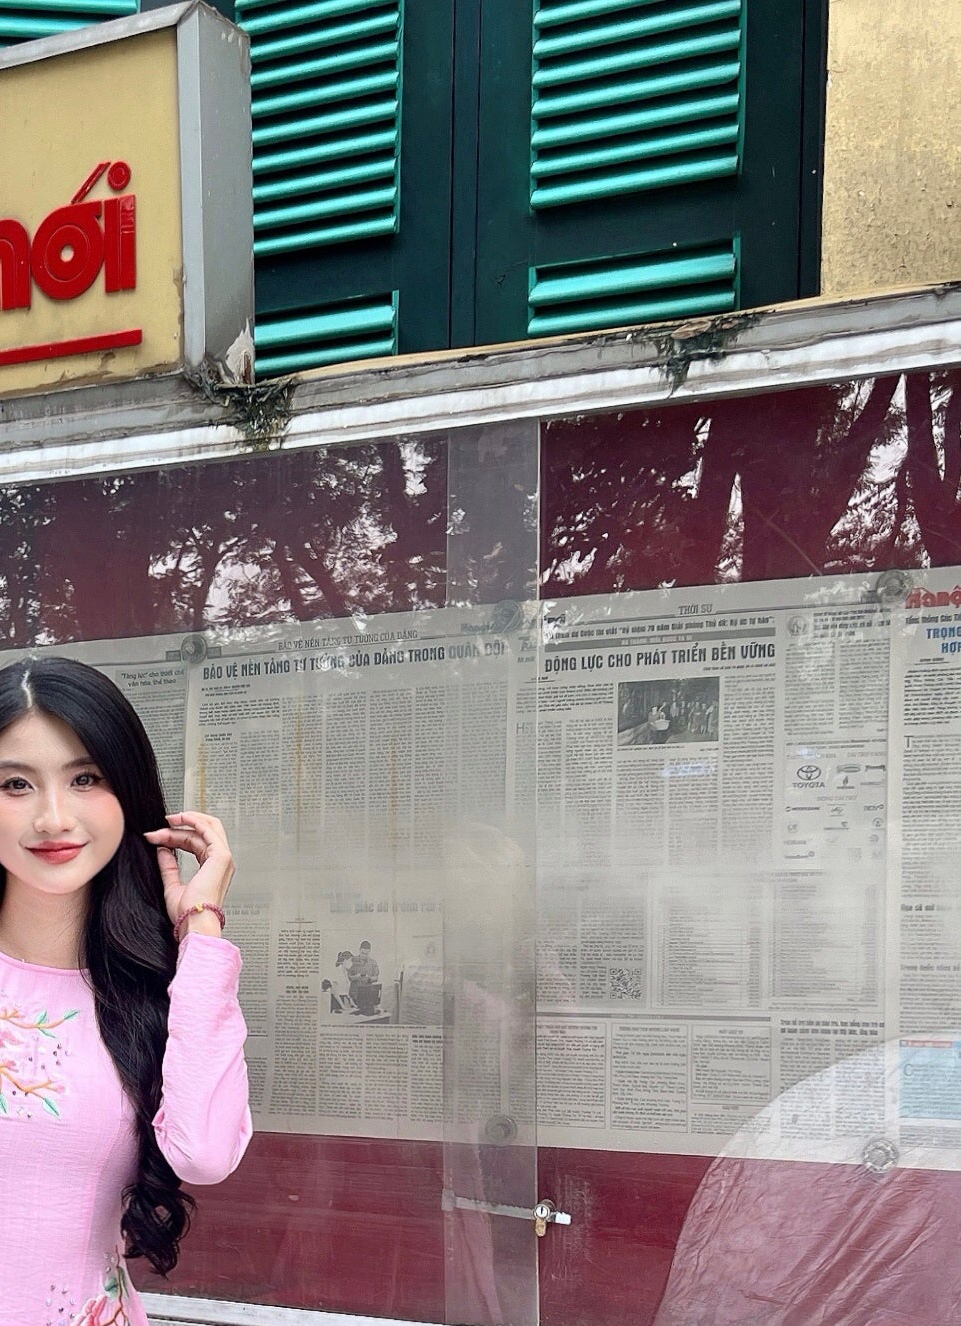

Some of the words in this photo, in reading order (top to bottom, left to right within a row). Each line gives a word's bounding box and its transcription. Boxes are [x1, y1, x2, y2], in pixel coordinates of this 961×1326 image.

[408, 646, 445, 662] TRONG
[545, 656, 576, 673] ĐỘNG
[581, 654, 603, 674] LỰC
[608, 652, 632, 667] CHO
[636, 649, 667, 666] PHÁT
[671, 643, 707, 663] TRIỂN
[711, 641, 736, 661] BỀN
[740, 643, 776, 659] VỮNG
